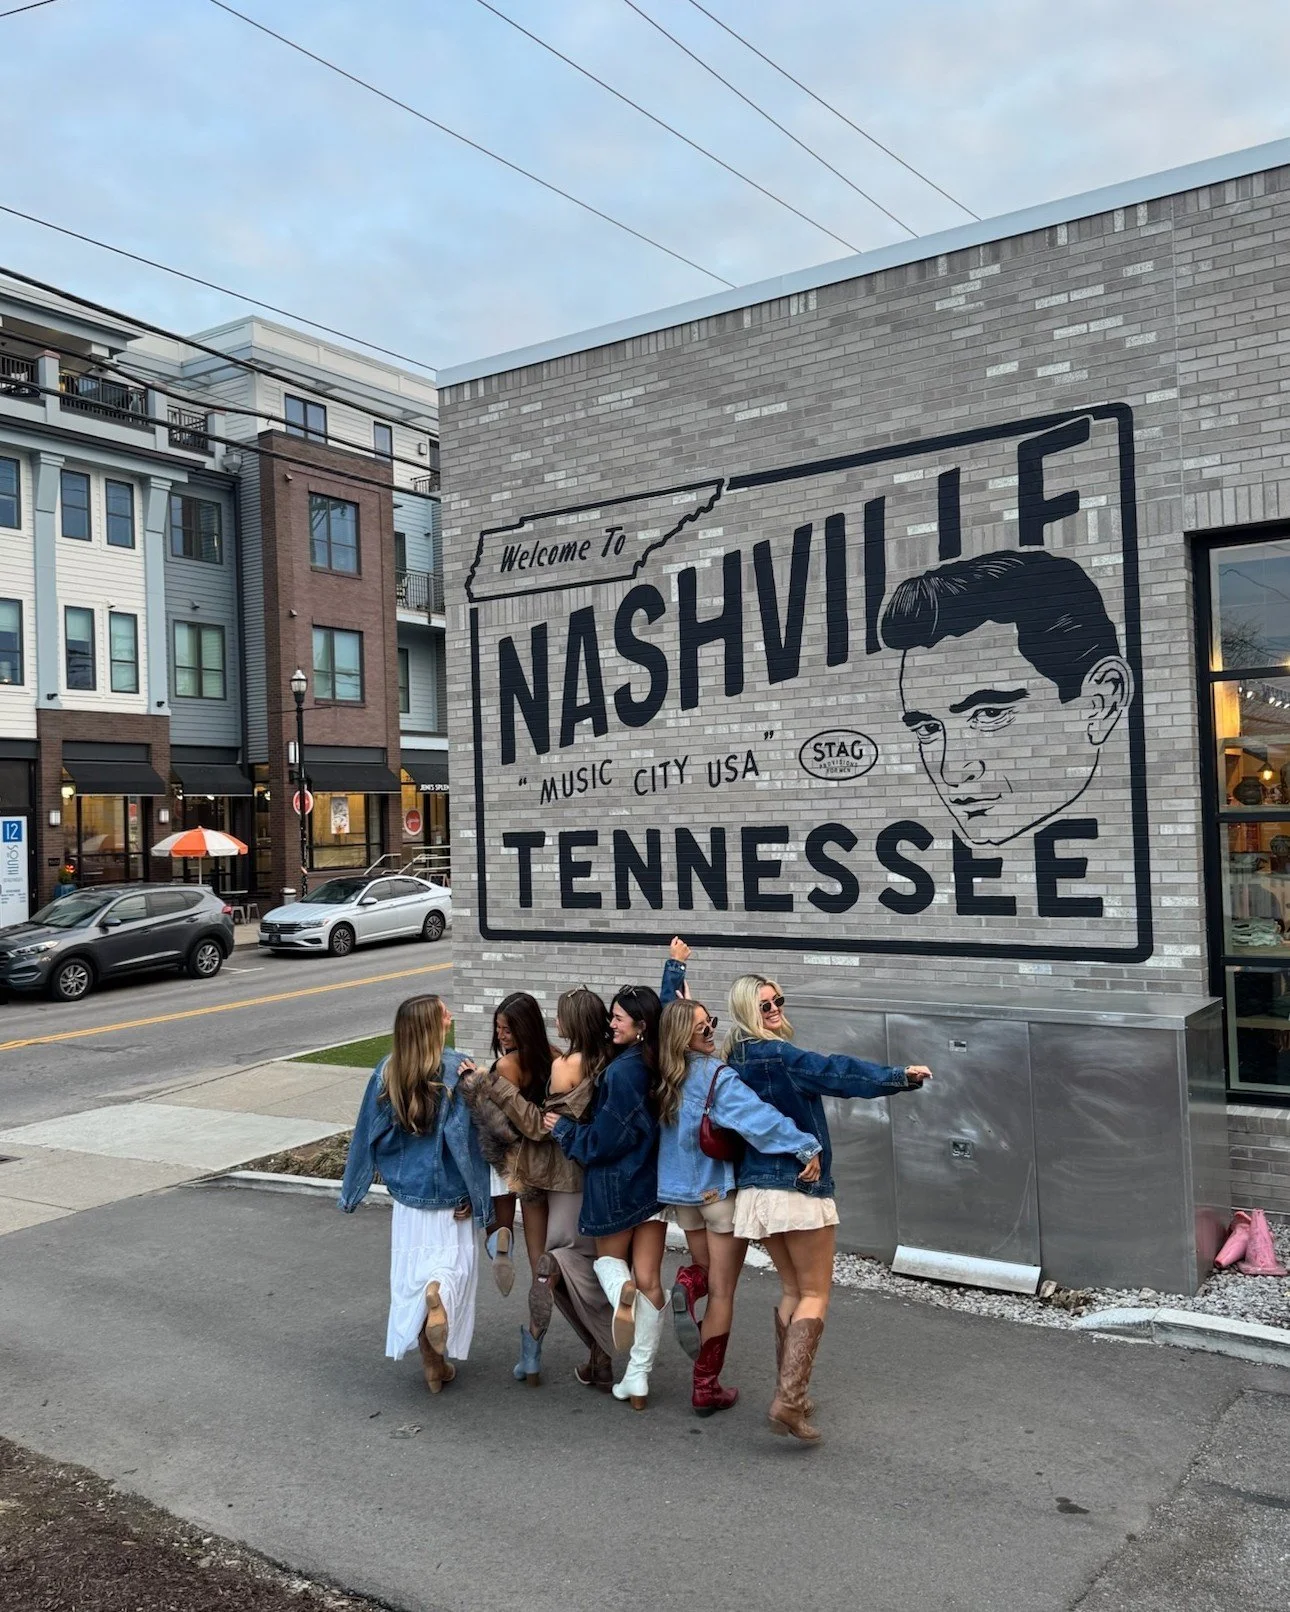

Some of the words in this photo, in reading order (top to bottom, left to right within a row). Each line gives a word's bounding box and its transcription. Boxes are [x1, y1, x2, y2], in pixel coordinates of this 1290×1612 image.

[500, 540, 591, 573] Welcome
[601, 526, 626, 557] To
[813, 740, 863, 762] STAG
[634, 755, 689, 796] CITY
[6, 823, 19, 840] 12
[7, 844, 19, 875] SOUTH
[502, 818, 1104, 918] TENNESSEE
